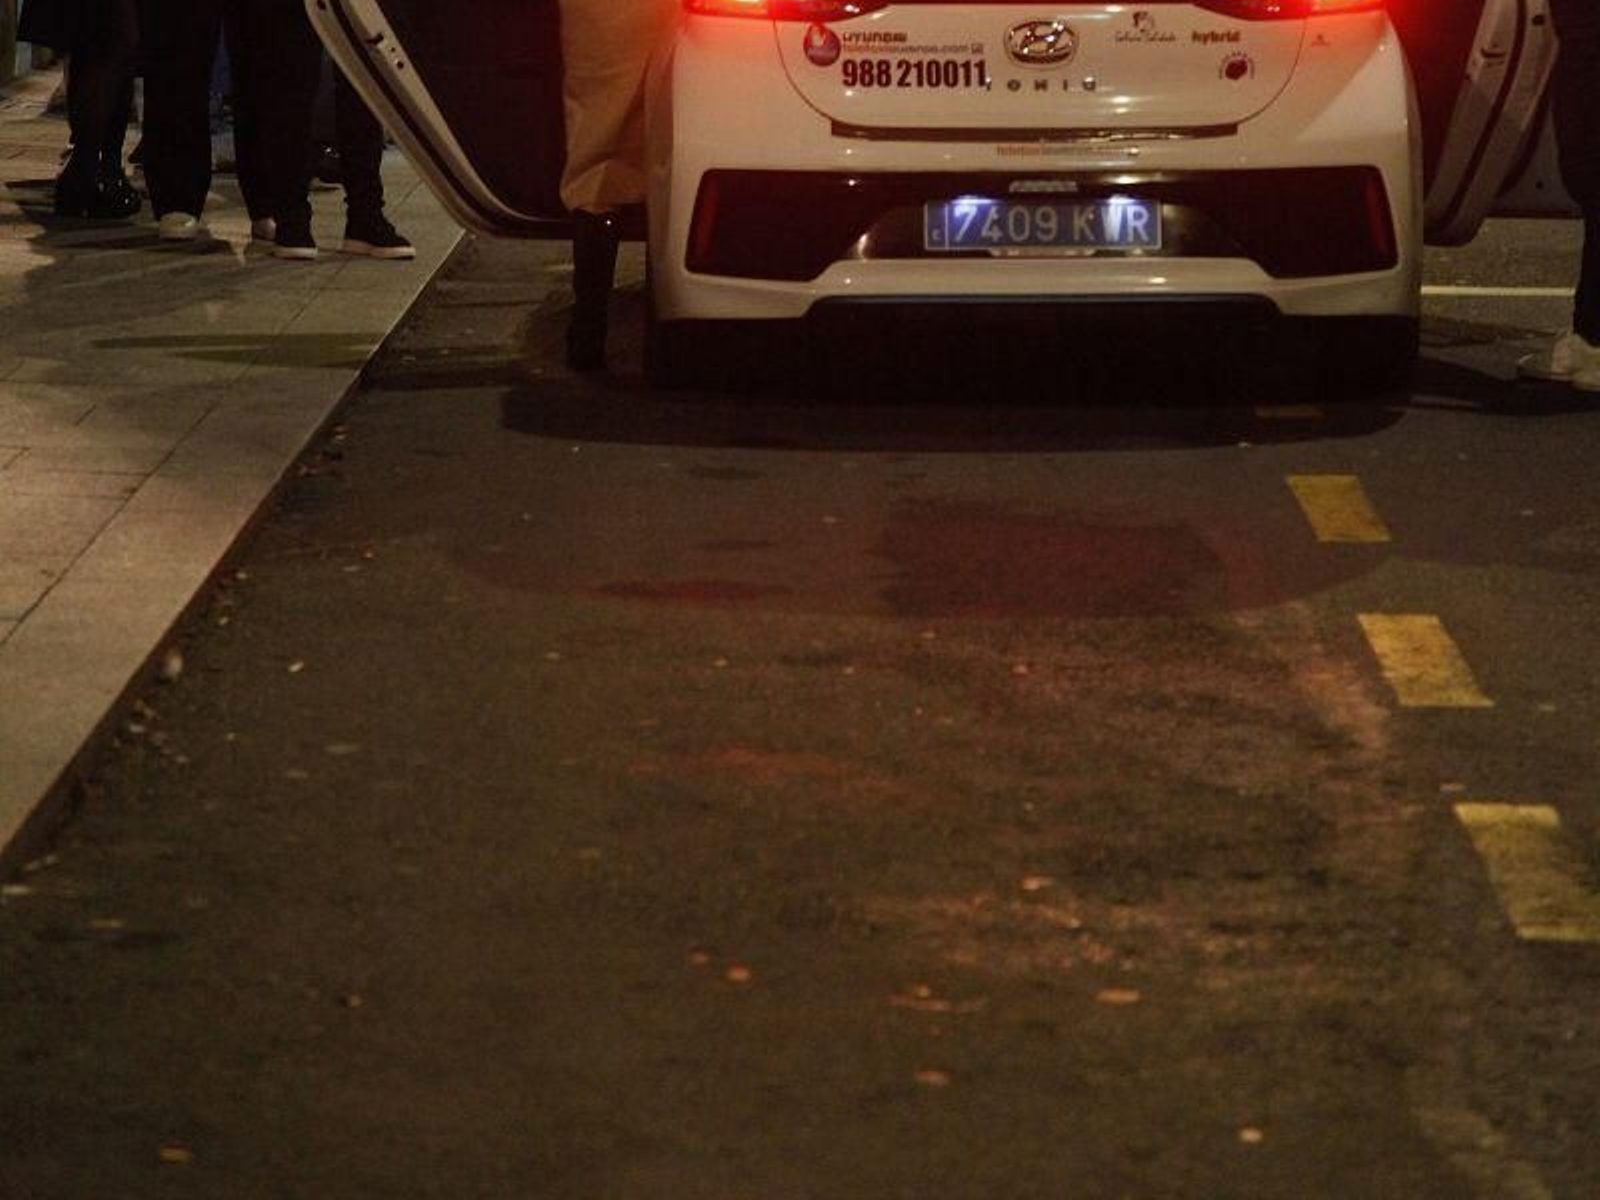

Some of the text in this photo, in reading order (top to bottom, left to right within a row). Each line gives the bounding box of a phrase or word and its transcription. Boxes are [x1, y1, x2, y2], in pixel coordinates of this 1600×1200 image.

[1191, 30, 1241, 45] hybrid
[842, 59, 986, 88] 988 210011
[953, 204, 1058, 242] 7409
[1073, 204, 1149, 242] KWR
